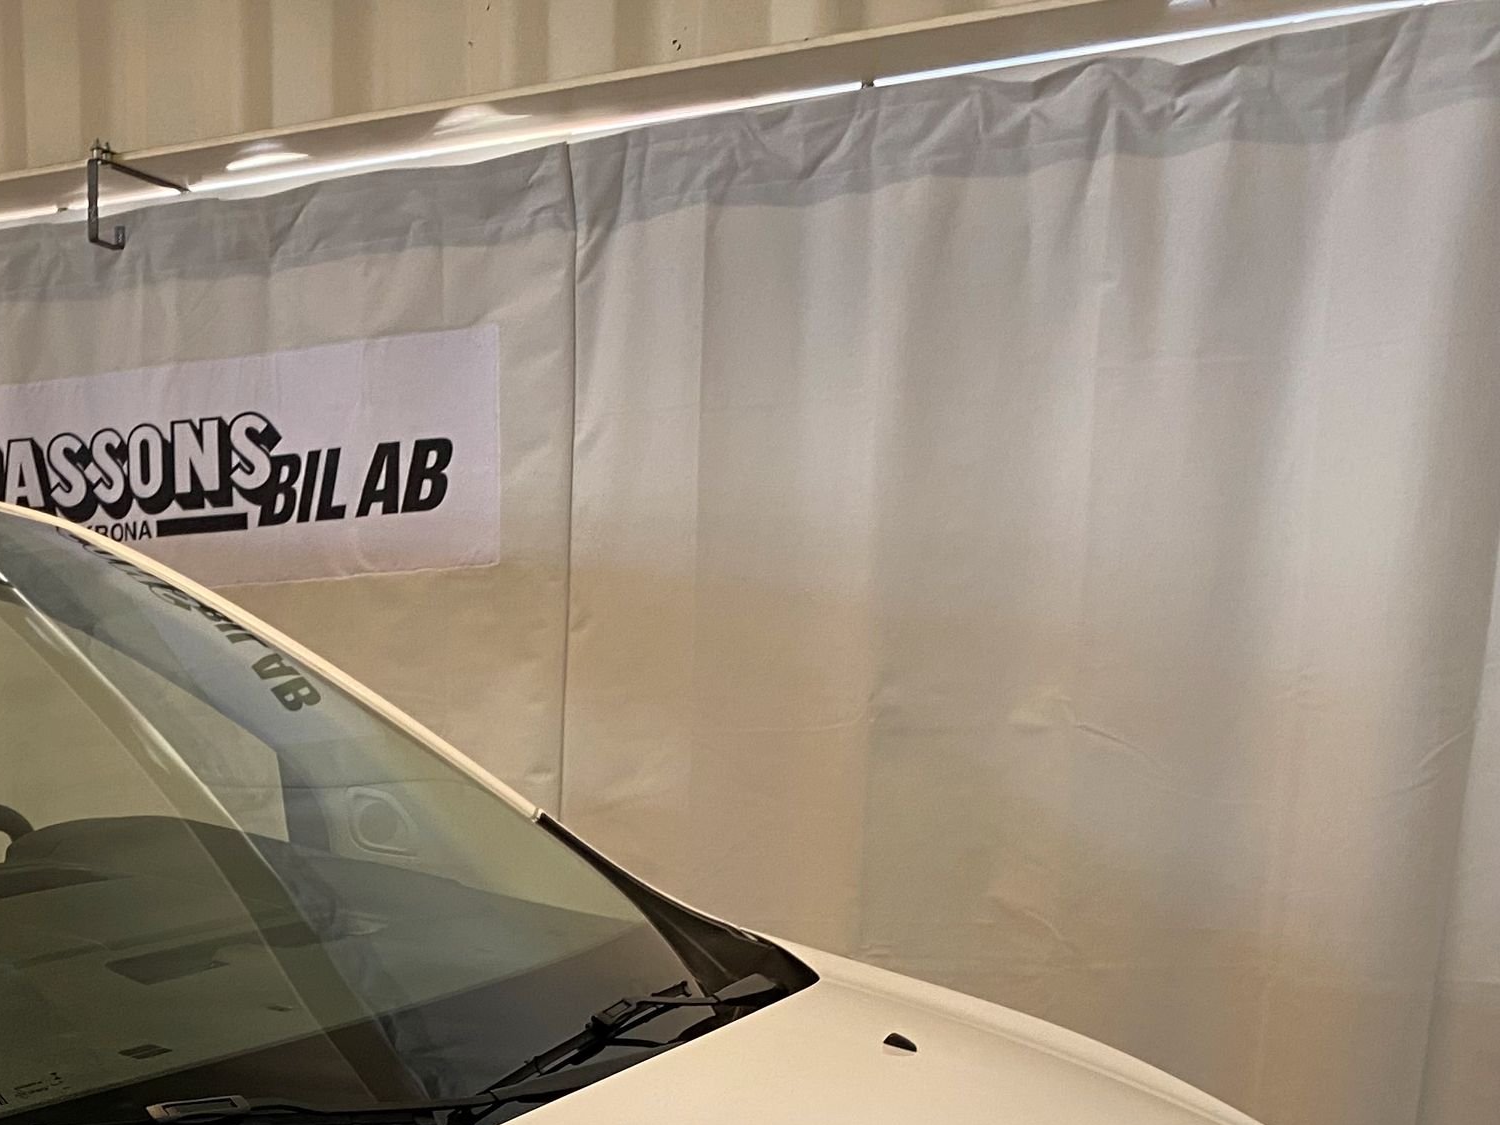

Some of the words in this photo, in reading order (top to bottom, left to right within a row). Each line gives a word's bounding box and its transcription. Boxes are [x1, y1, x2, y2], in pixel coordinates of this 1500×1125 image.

[257, 447, 347, 527] BIL
[355, 437, 454, 518] AB
[87, 520, 152, 542] RONA
